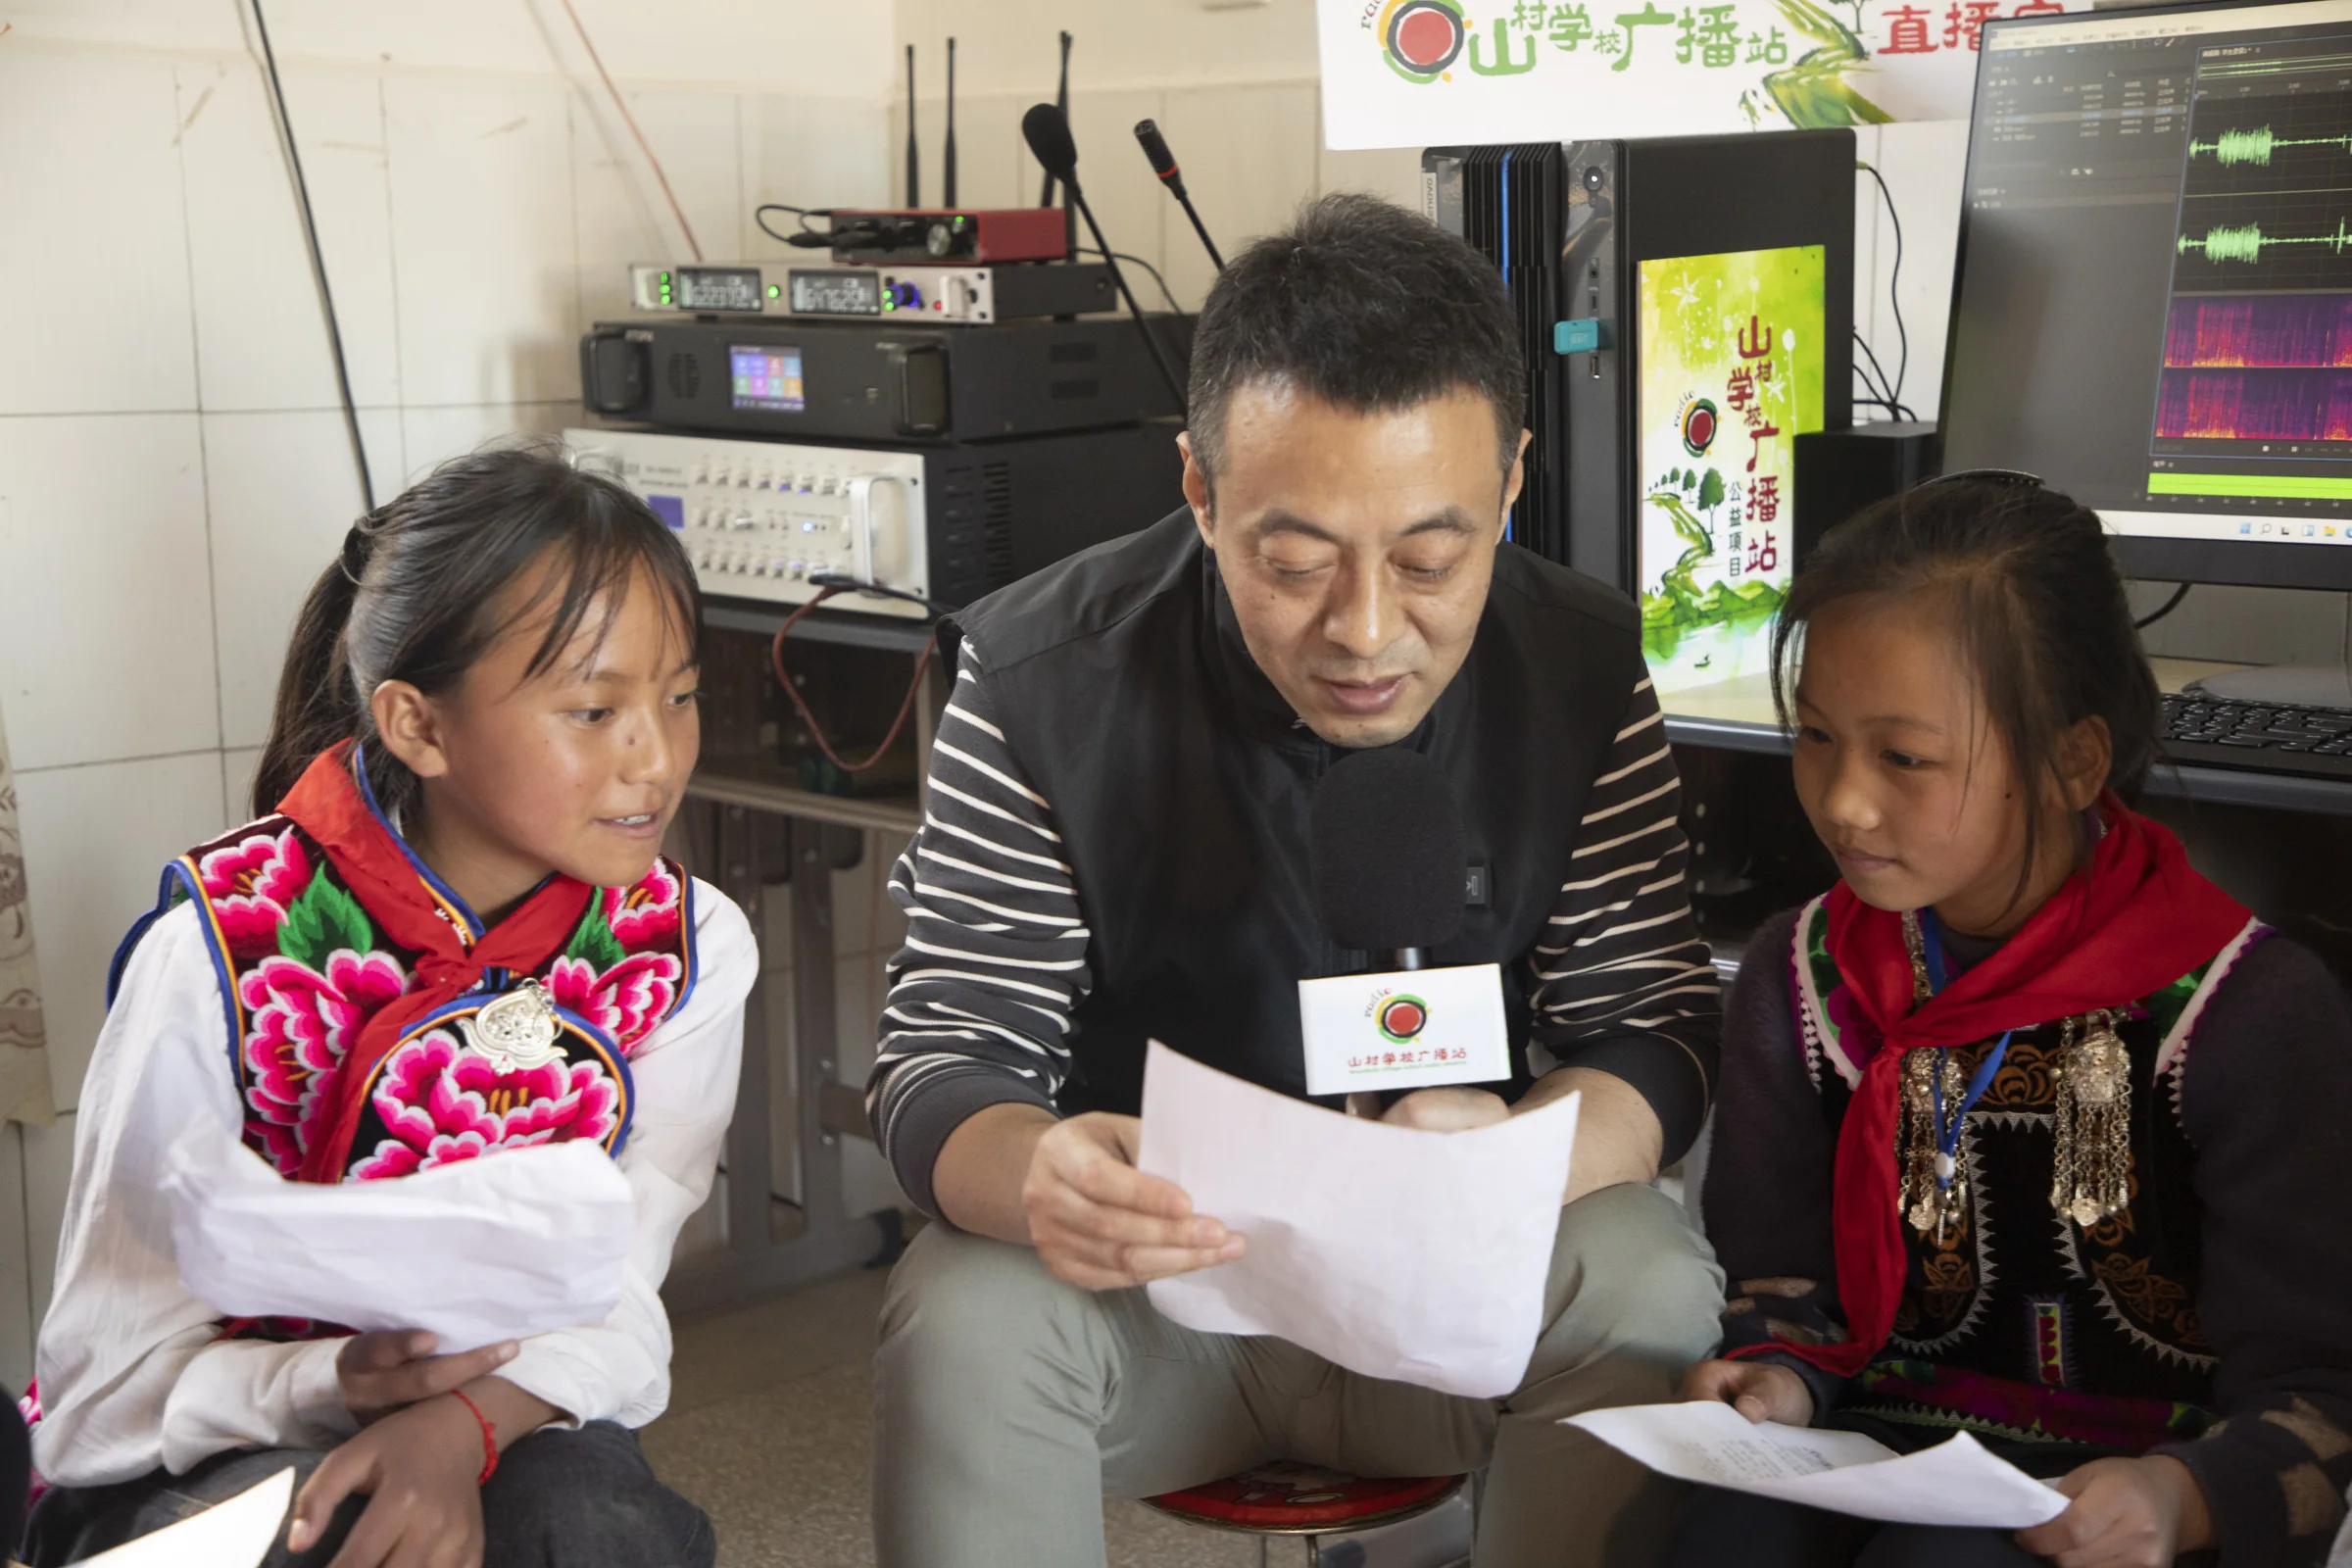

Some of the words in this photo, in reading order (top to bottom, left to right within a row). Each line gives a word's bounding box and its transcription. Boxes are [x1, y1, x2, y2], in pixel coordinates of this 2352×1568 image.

[1468, 0, 1788, 75] 山村学校广播站
[1727, 315, 1780, 573] 山村学校广播站
[1728, 481, 1742, 577] 公益项目
[1348, 1047, 1467, 1068] 山村学校广播站
